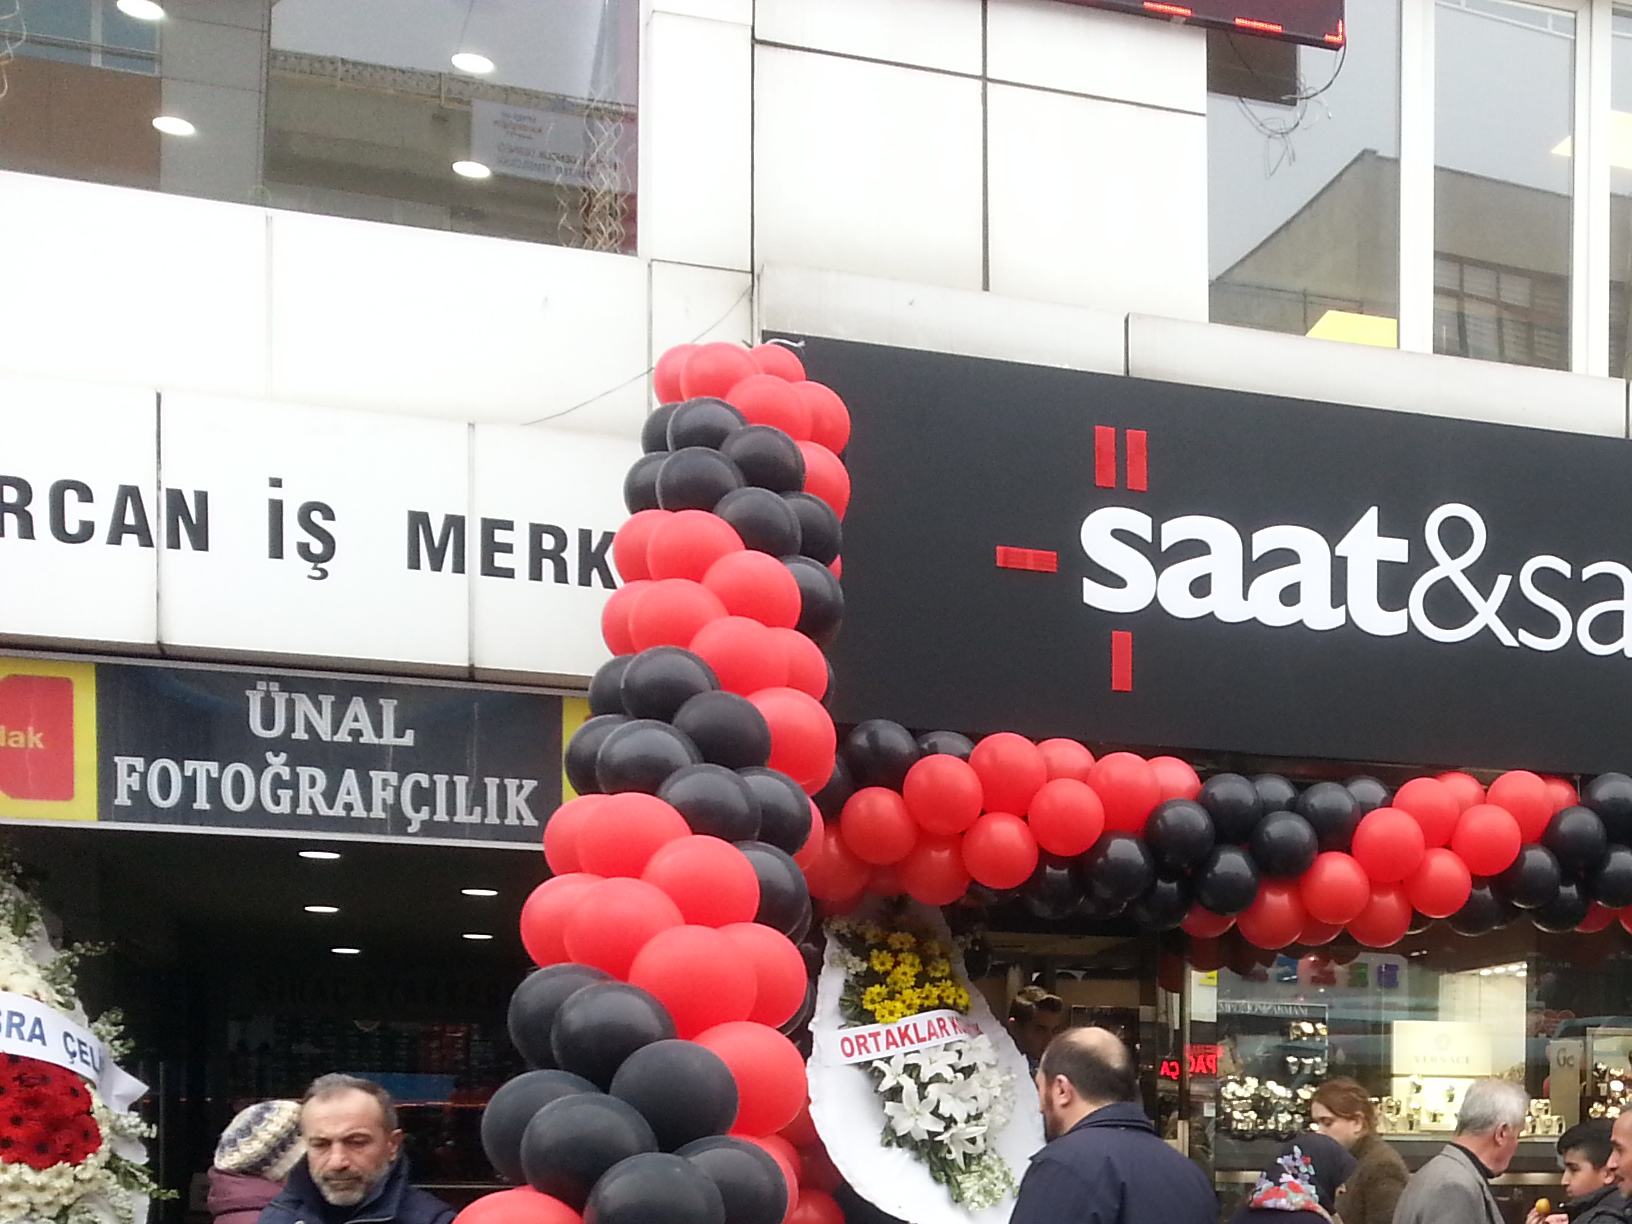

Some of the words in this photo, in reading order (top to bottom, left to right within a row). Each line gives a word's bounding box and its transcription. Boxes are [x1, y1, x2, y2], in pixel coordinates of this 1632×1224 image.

[0, 475, 209, 552] RCAN
[267, 477, 337, 581] İŞ
[246, 680, 415, 747] ÜNAL
[114, 751, 538, 834] FOTOĞRAFÇILIK
[841, 1017, 950, 1058] ORTAKLAR
